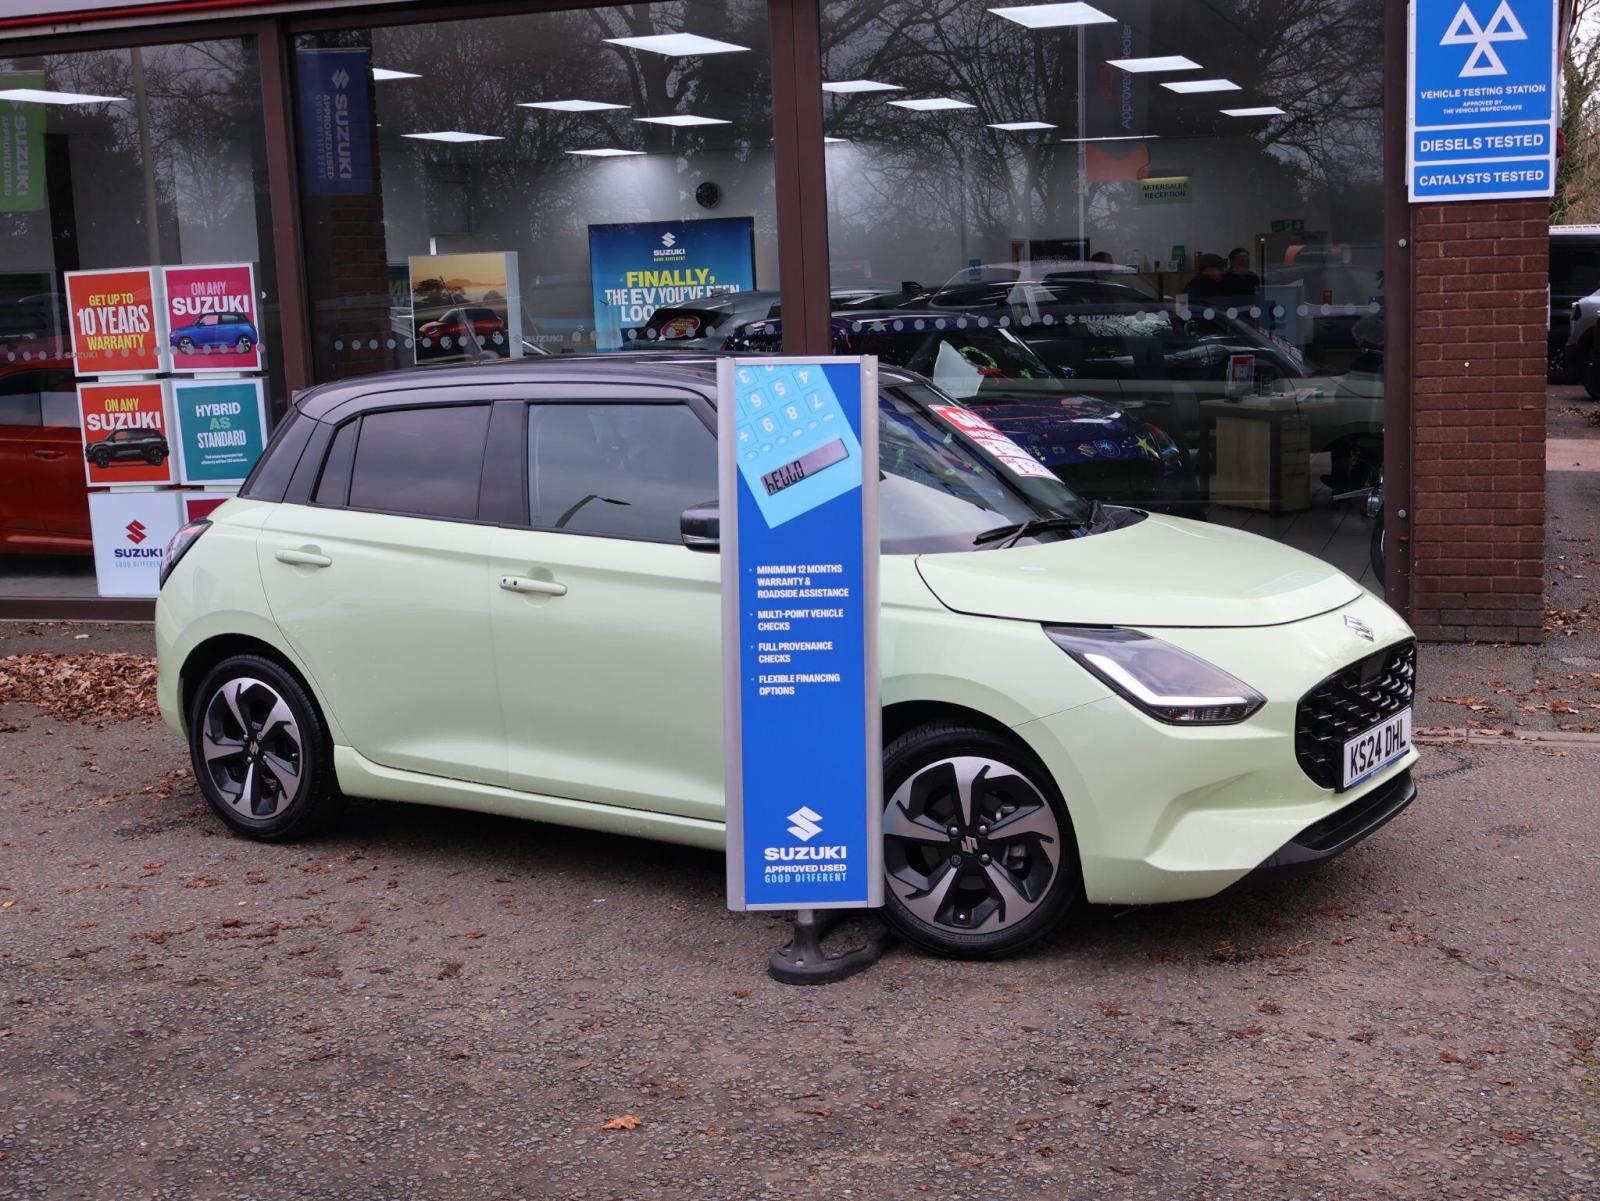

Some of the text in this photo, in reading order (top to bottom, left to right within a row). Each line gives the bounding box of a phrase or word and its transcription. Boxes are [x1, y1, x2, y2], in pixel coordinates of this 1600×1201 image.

[1420, 84, 1546, 100] VEHICLE TESTING STATION
[322, 95, 334, 180] APPROVED USED
[335, 94, 352, 179] SUZUKI
[1420, 134, 1544, 152] DIESELS TESTED
[14, 114, 30, 198] SUZUKI
[1419, 170, 1544, 187] CATALYSTS TESTED
[653, 248, 686, 256] SUZUKI
[626, 268, 716, 288] FINALLY,
[191, 280, 226, 296] ON ANY
[88, 293, 134, 306] GET UP TO
[604, 288, 628, 306] THE
[630, 288, 656, 305] EV
[172, 295, 250, 316] SUZUKI
[77, 304, 150, 336] 10 YEARS
[86, 333, 144, 351] WARRANTY
[525, 334, 564, 343] SUZUKI
[104, 398, 139, 412] ON ANY
[195, 402, 240, 417] HYBRID
[86, 410, 162, 431] SUZUKI
[209, 416, 231, 430] AS
[197, 430, 247, 448] STANDARD
[114, 548, 163, 558] SUZUKI
[757, 564, 842, 574] MINIMUM 12 MONTHS
[757, 576, 810, 586] WARRANTY &
[758, 588, 849, 598] ROADSIDE ASSISTANCE
[758, 608, 844, 618] MULTI-POINT VEHICLE
[758, 622, 790, 630] CHECKS
[758, 642, 833, 651] FULL PROVENANCE
[758, 654, 791, 663] CHECKS
[759, 674, 840, 684] FLEXIBLE FINANCING
[759, 686, 795, 696] OPTIONS
[1350, 719, 1406, 778] KS24 DHL
[764, 846, 847, 861] SUZUKI
[764, 864, 847, 873] APPROVED USED
[764, 873, 847, 883] GOOD DIFFERENT
